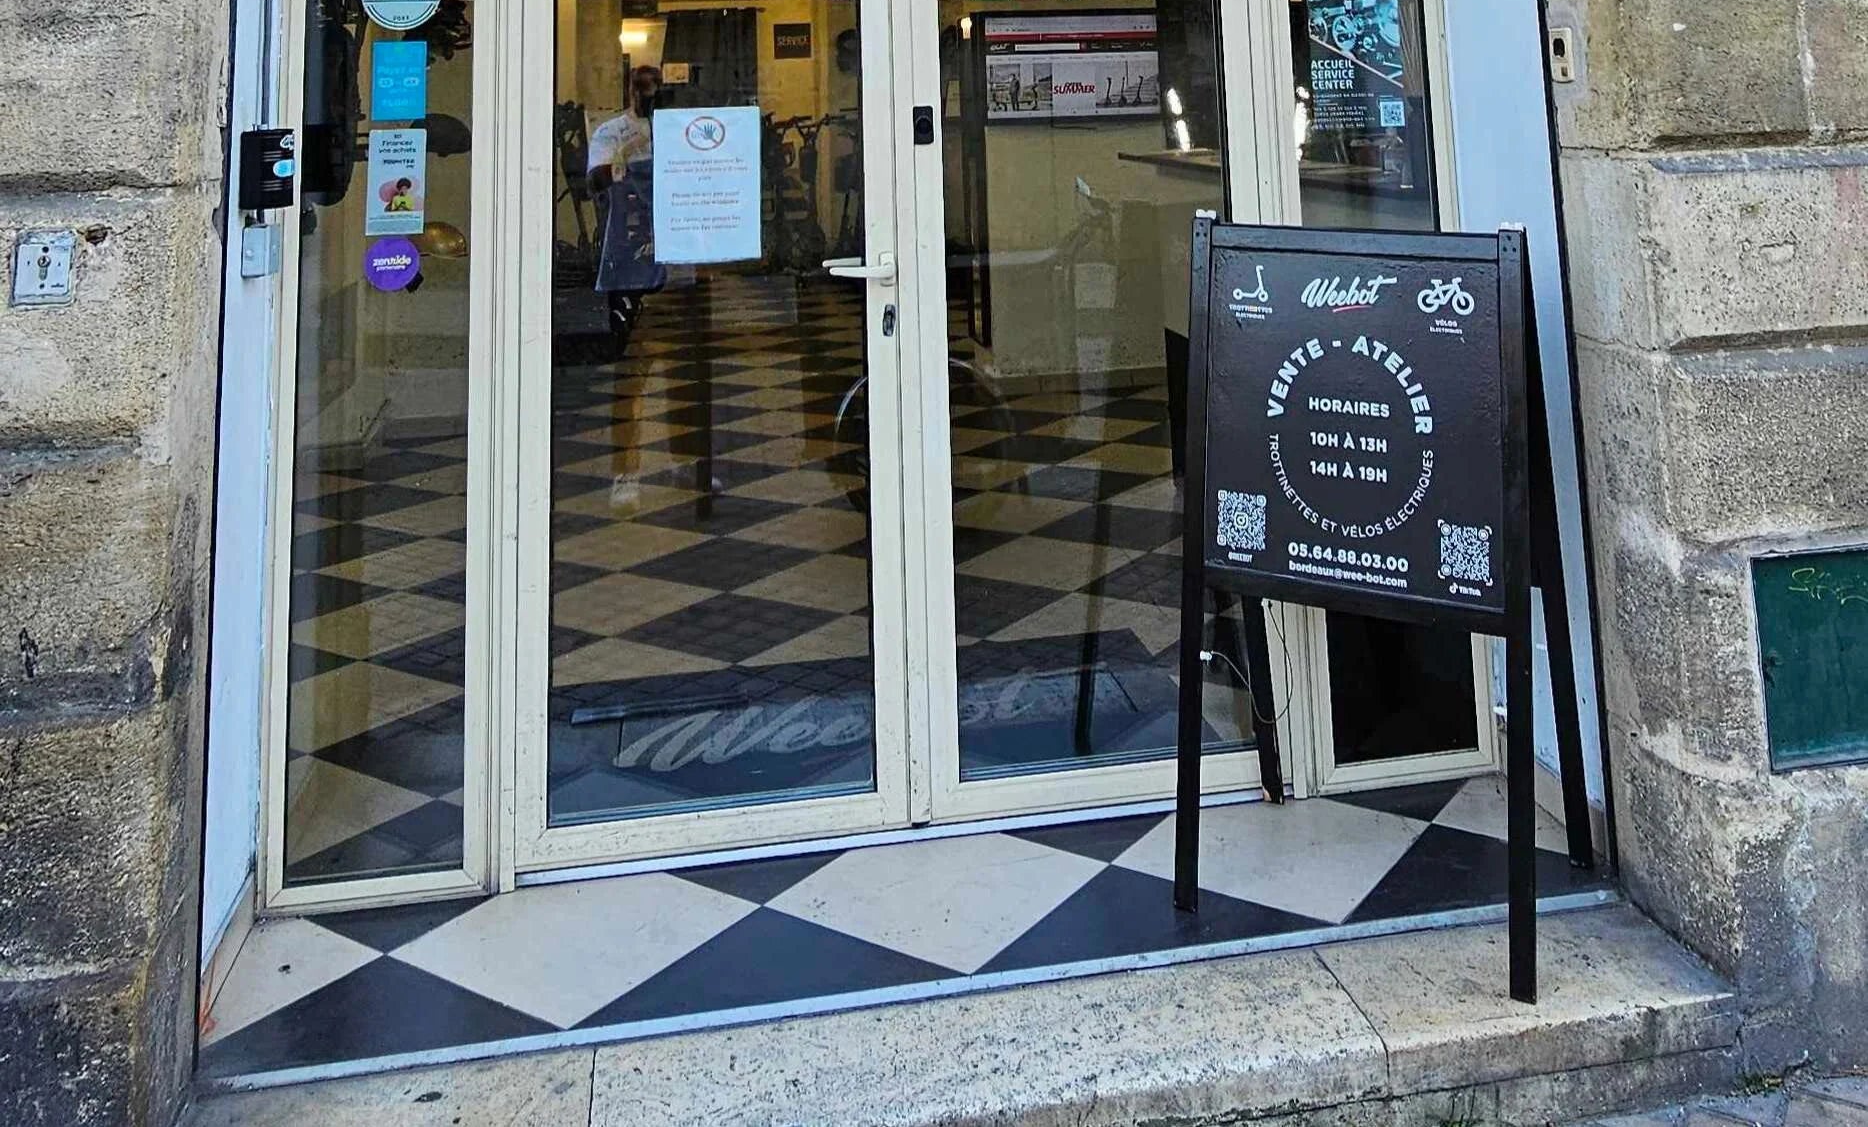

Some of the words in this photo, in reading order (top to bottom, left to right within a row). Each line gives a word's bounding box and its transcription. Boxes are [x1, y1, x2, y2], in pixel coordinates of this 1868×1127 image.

[1311, 59, 1355, 70] ACCUEIL
[1311, 69, 1355, 79] SERVICE
[1312, 79, 1354, 90] CENTER
[1301, 275, 1398, 309] Weebot
[1267, 337, 1325, 418] VENTE
[1352, 335, 1433, 434] ATELIER
[1308, 396, 1391, 419] HORAIRES
[1309, 431, 1339, 449] 10H
[1342, 431, 1355, 449] À
[1359, 436, 1388, 454] 13H
[1309, 460, 1338, 478] 14H
[1342, 461, 1355, 479] À
[1358, 465, 1388, 483] 19H
[1268, 433, 1318, 524] TROTTINETTES
[1321, 518, 1338, 534] ET
[1341, 523, 1384, 539] VÉLOS
[1386, 448, 1434, 531] ÉLECTRIQUES
[1287, 541, 1409, 573] 05.64.88.03.00
[1288, 559, 1408, 589] bordeaux@wee-bot.com
